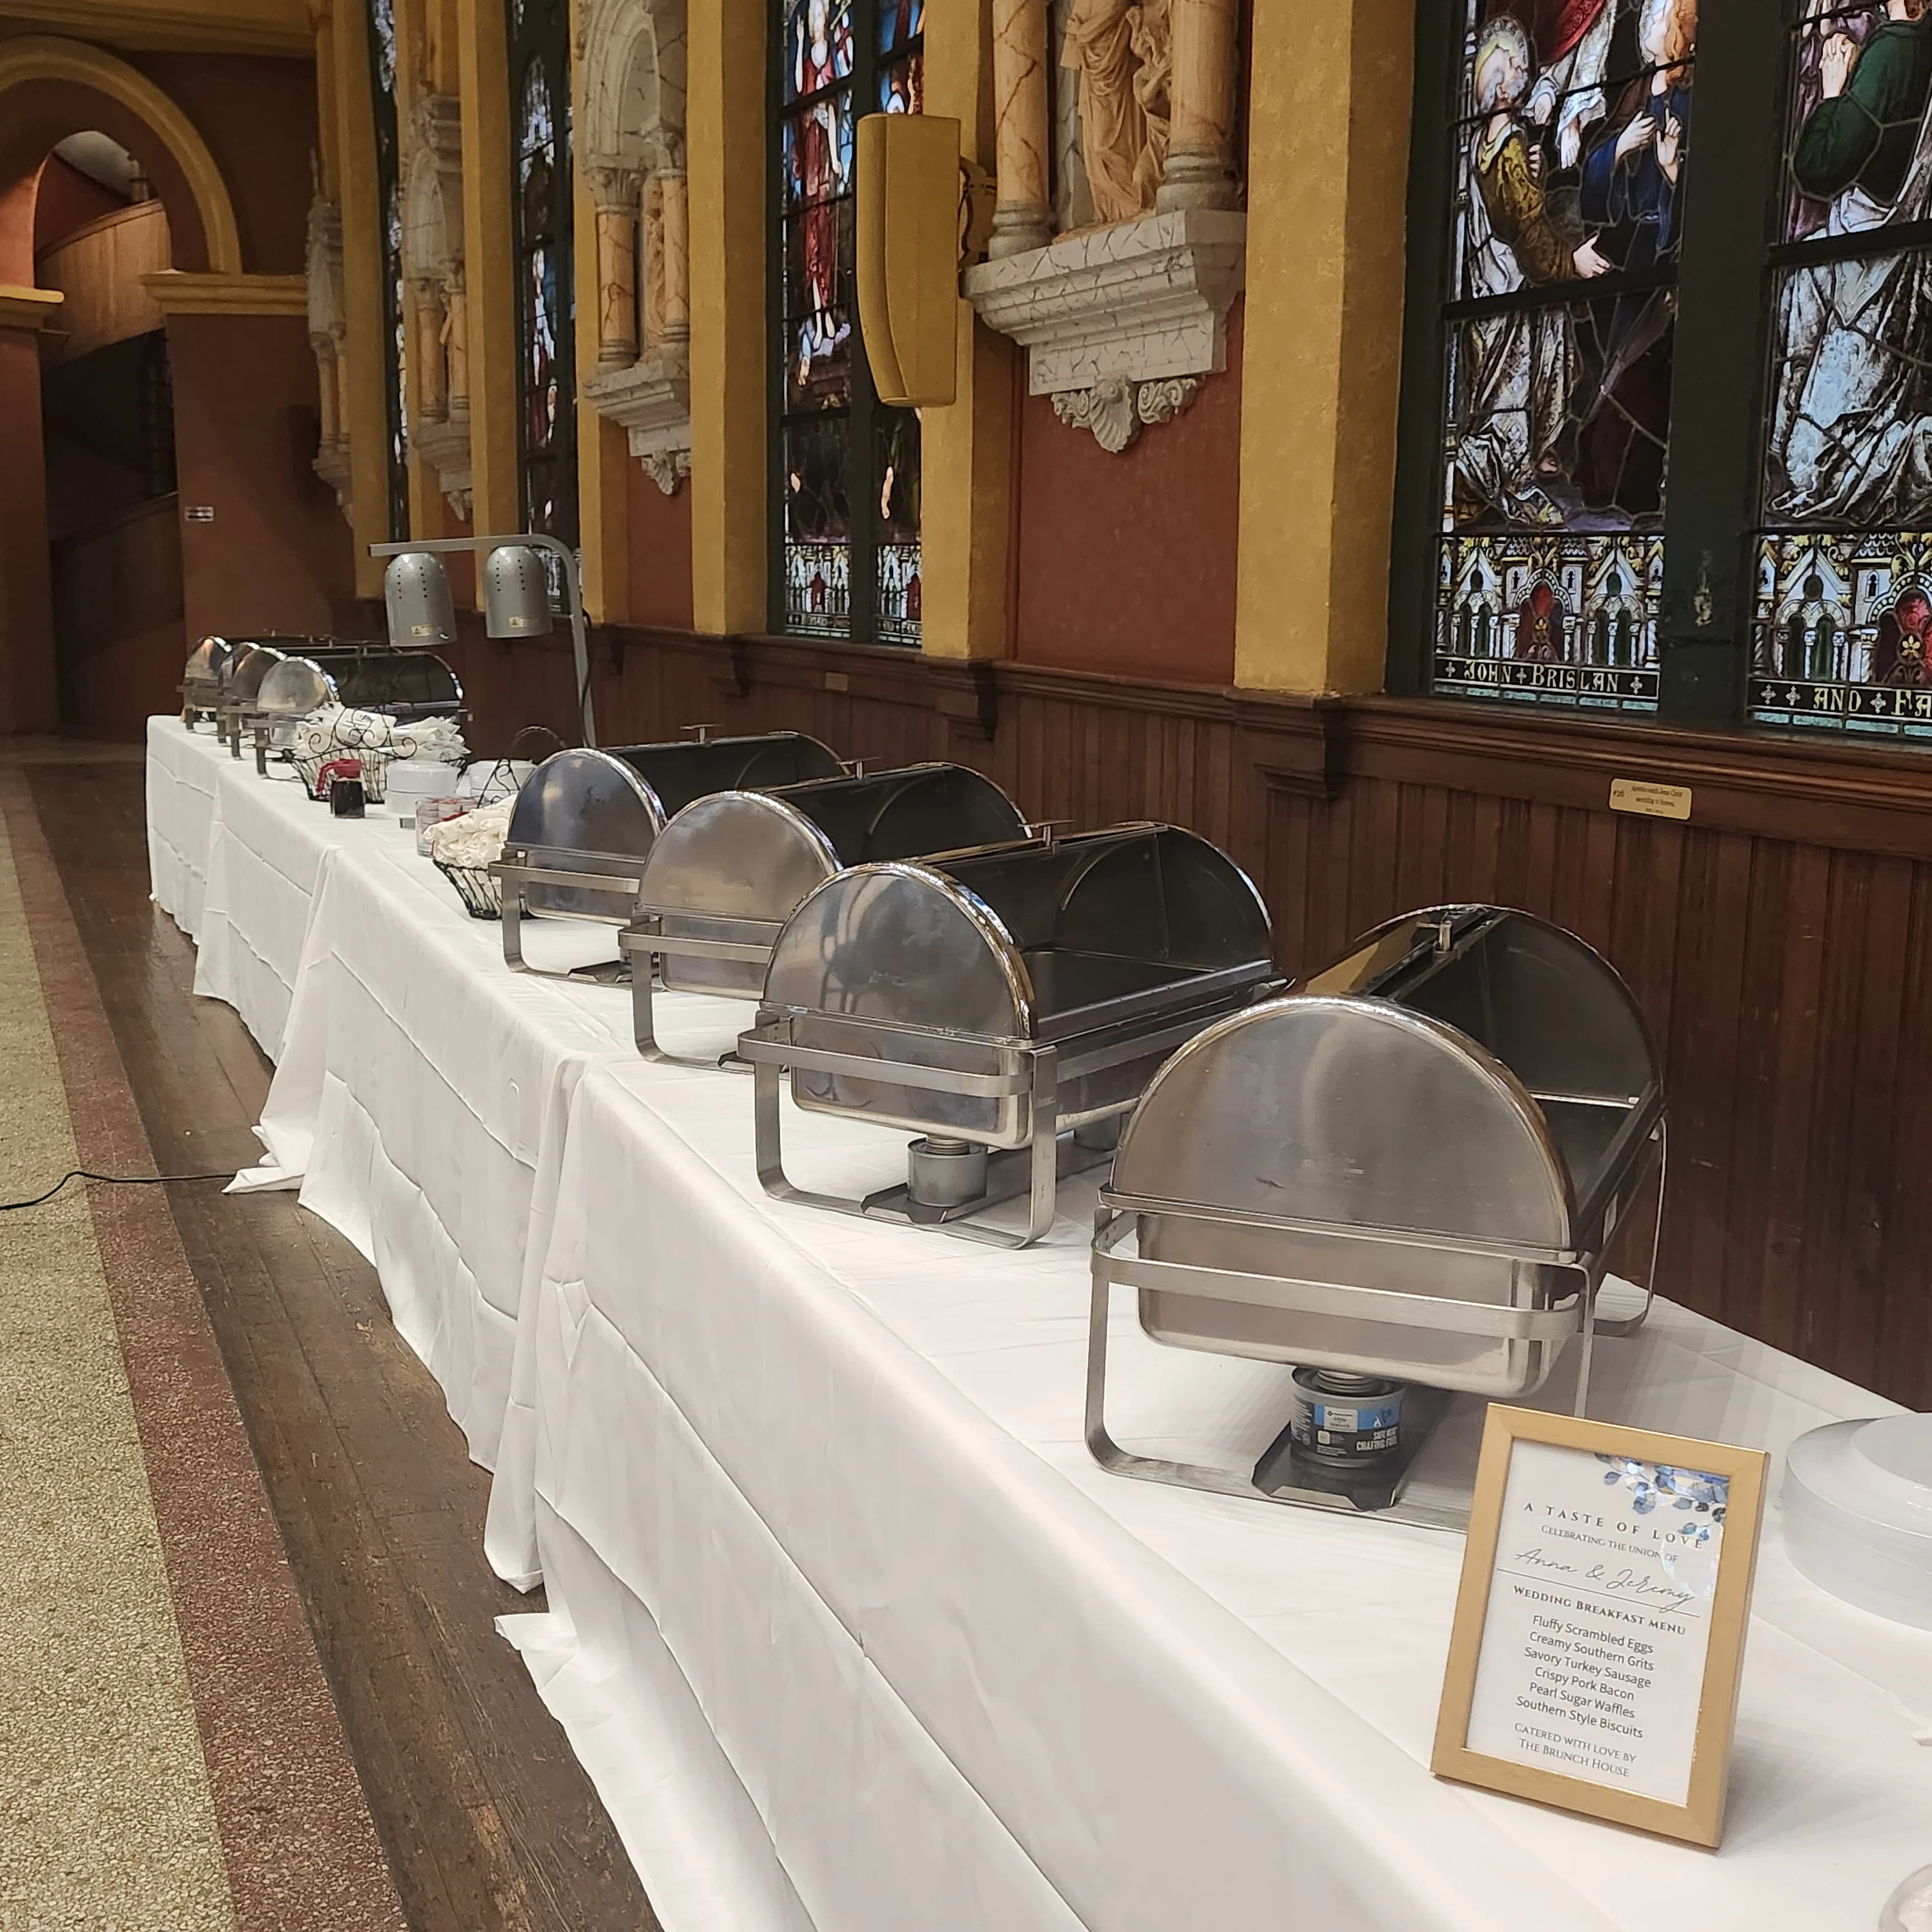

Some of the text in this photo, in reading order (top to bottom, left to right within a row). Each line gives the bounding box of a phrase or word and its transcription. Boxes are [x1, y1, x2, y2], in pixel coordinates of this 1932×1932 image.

[1464, 660, 1618, 692] JOHN BRISLAN
[1813, 687, 1862, 712] AND
[1525, 1502, 1703, 1549] A TASTE OF LOVE
[1541, 1525, 1678, 1563] CELEBRATING THE UNION OF
[1515, 1548, 1578, 1573] Anna
[1585, 1564, 1605, 1581] &
[1514, 1585, 1686, 1635] WEDDING BREAKFAST MENU
[1529, 1631, 1654, 1671] Creamy Southern Grits
[1533, 1614, 1654, 1654] Fluffy Scrambled Eggs
[1524, 1647, 1651, 1689] Savory Turkey Sausage
[1534, 1667, 1635, 1701] Crispy Pork Bacon
[1516, 1696, 1643, 1738] Southern Style Biscuits
[1529, 1681, 1636, 1719] Pearl Sugar Waffles
[1514, 1723, 1636, 1763] CATERED WITH LOVE BY
[1519, 1738, 1629, 1777] THE BRUNCH HOUSE
